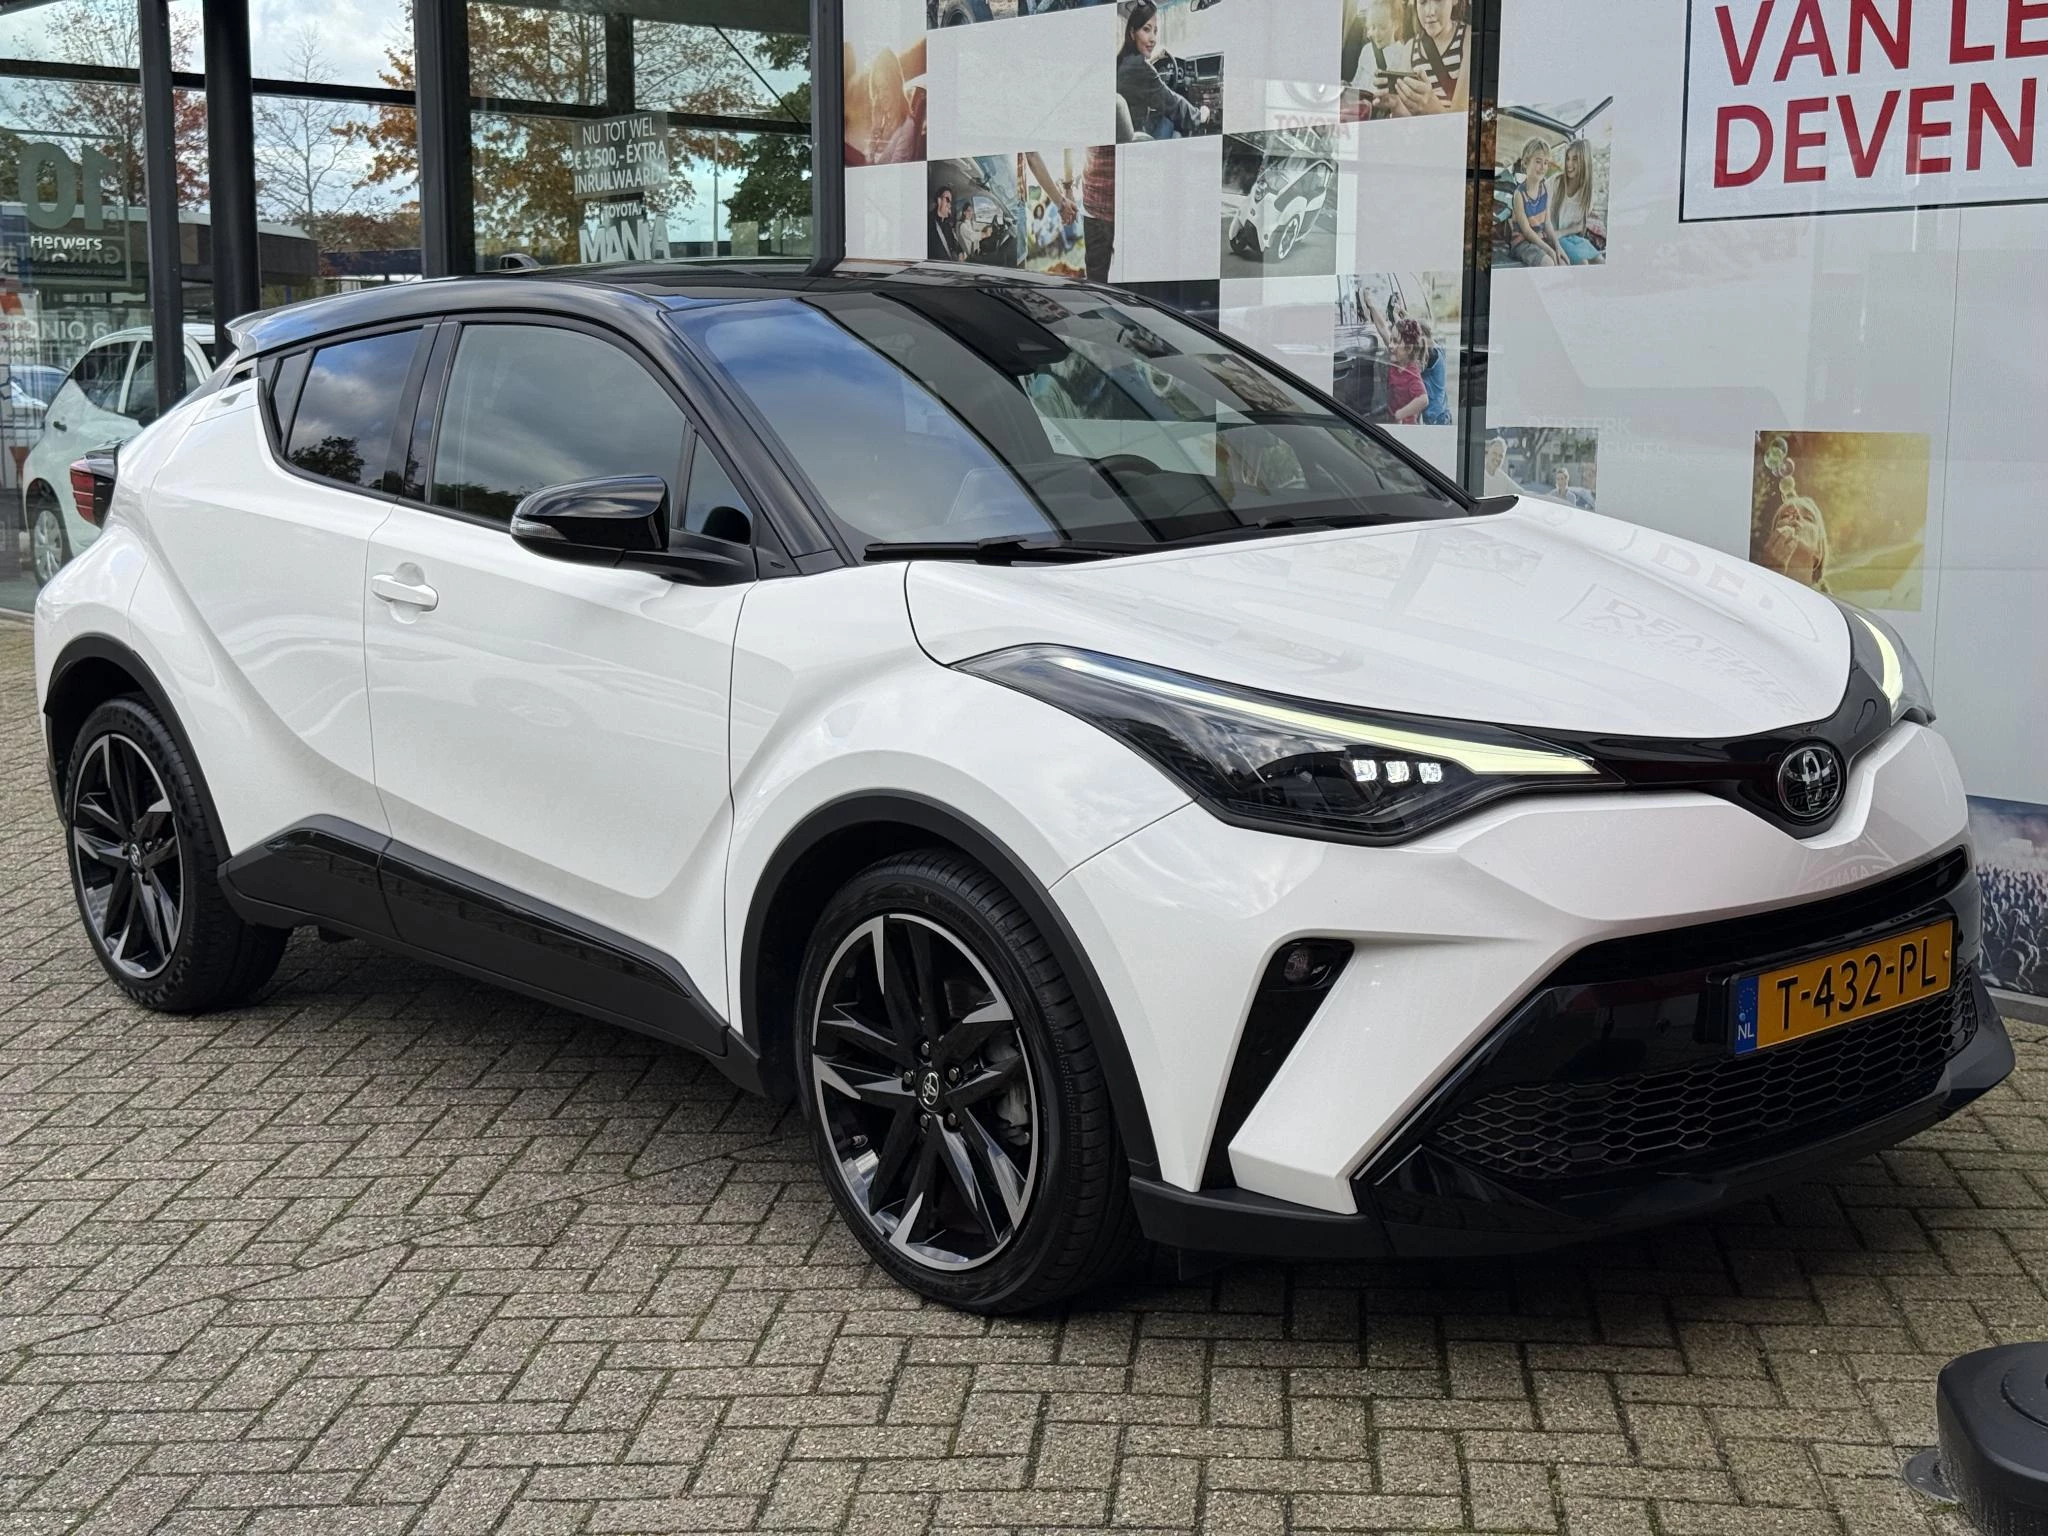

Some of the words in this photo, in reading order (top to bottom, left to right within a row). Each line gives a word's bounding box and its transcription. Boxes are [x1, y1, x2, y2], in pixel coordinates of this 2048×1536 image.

[1714, 0, 1911, 86] VAN
[582, 124, 601, 145] NU
[603, 120, 627, 142] TOT
[629, 117, 656, 139] WEL
[1713, 77, 2048, 188] DEVEN
[574, 152, 583, 170] €
[575, 166, 669, 194] INRUILWAARDE
[30, 235, 103, 251] Herwers
[579, 214, 671, 264] MANIA
[1776, 937, 1937, 1031] T-432-PL
[1737, 1022, 1755, 1041] NL
